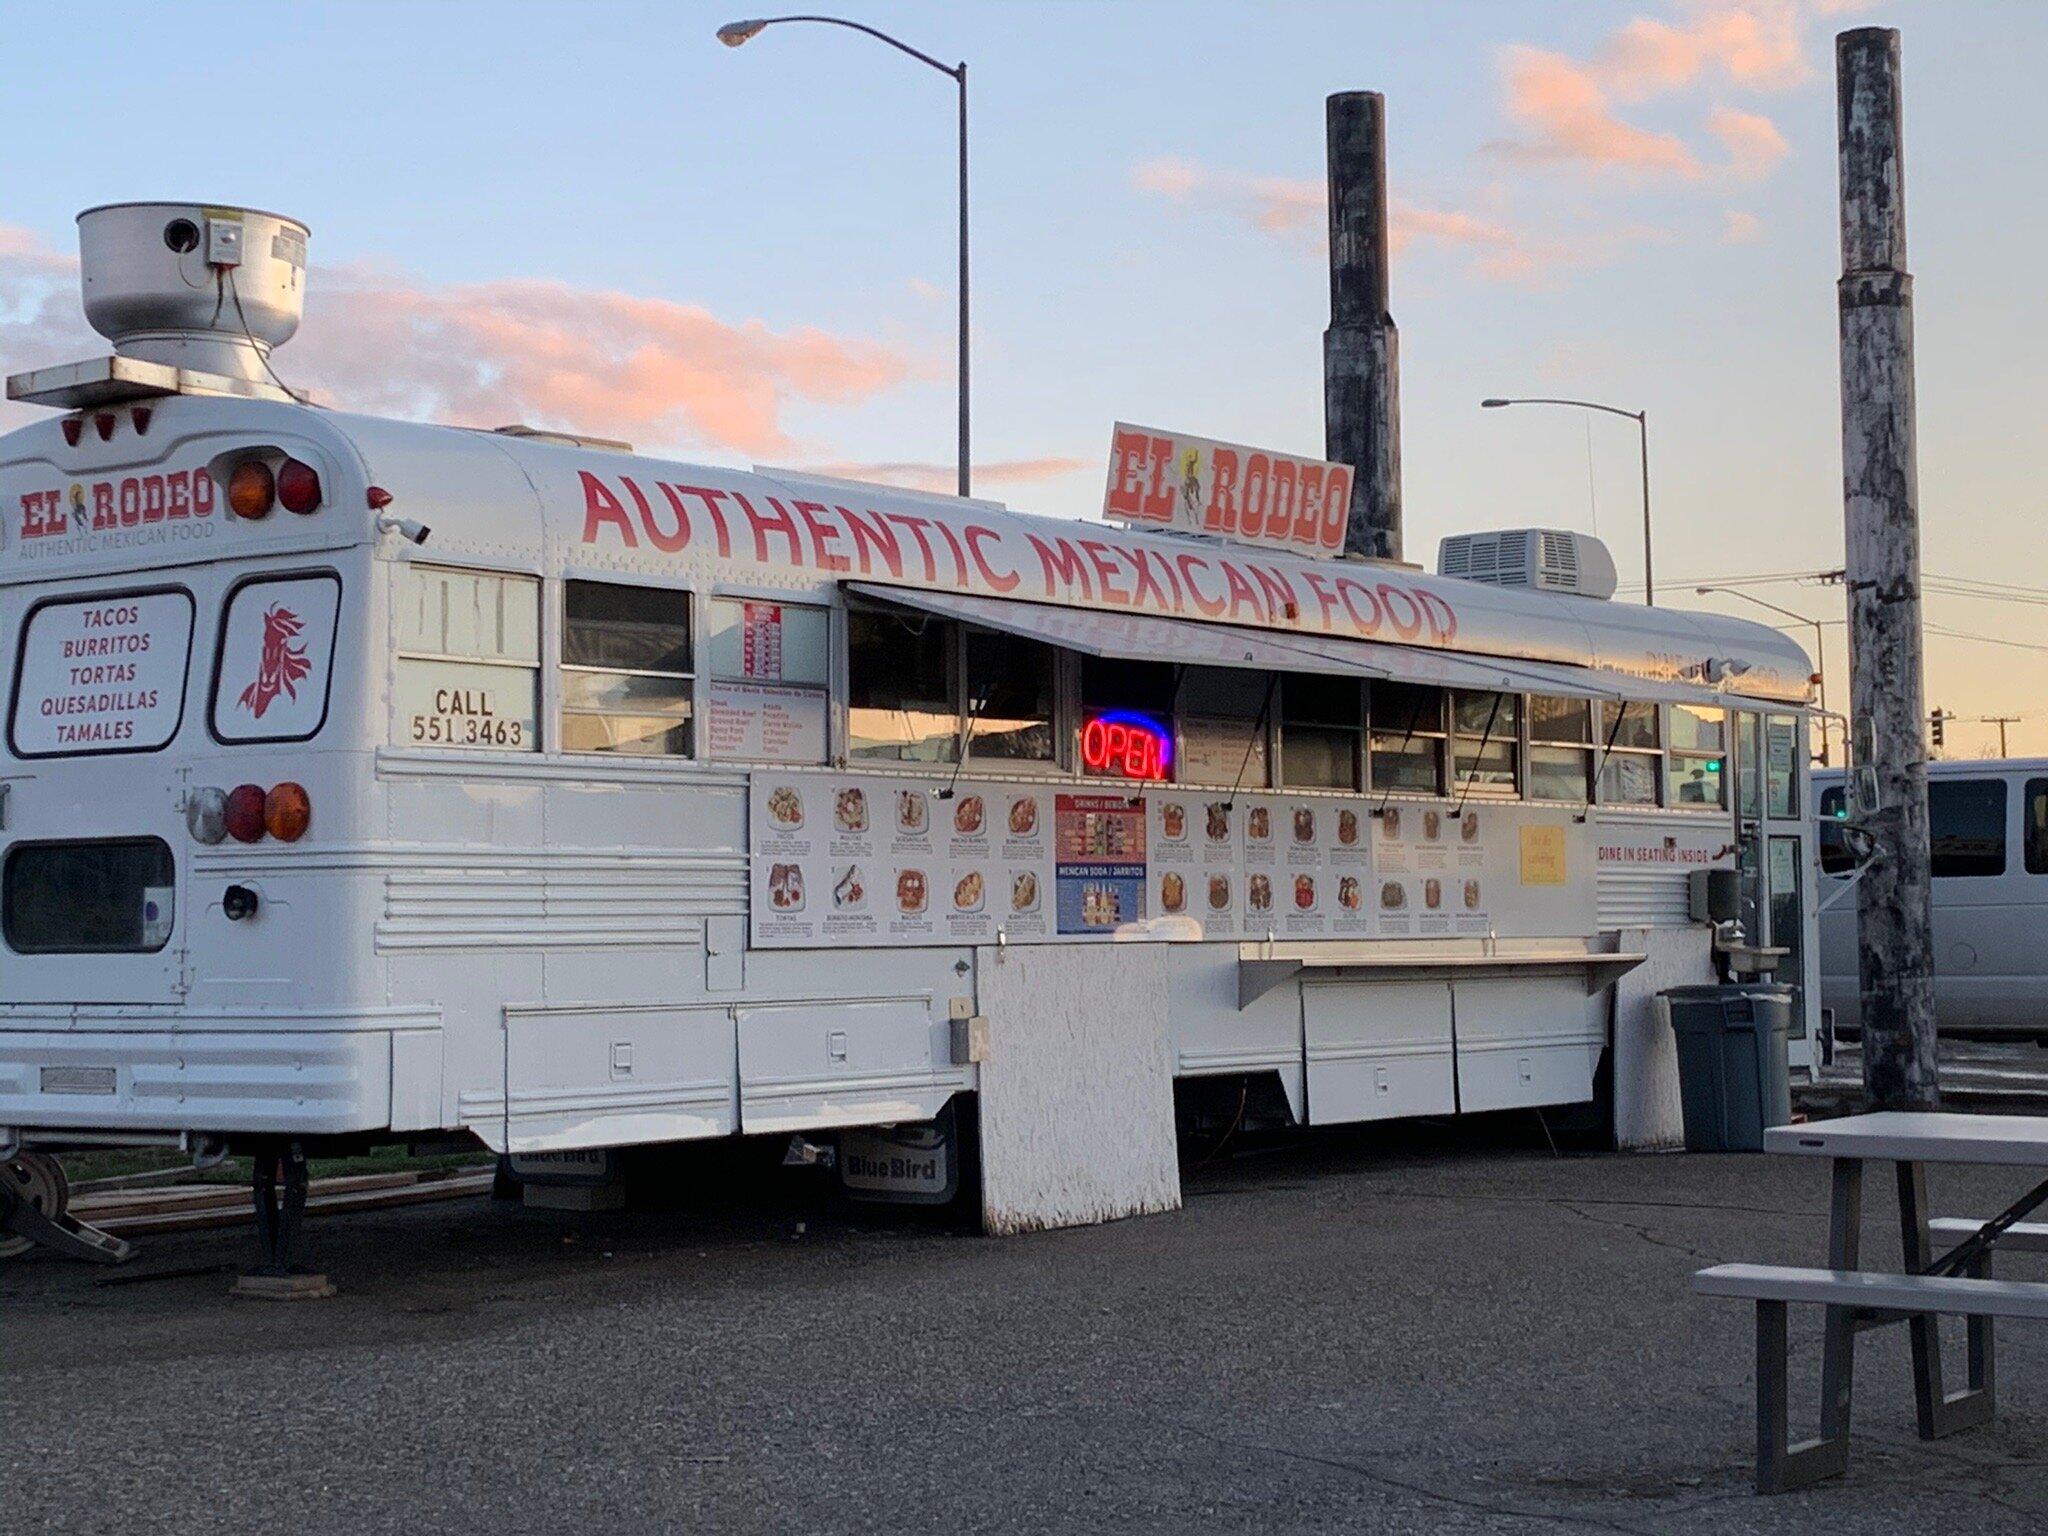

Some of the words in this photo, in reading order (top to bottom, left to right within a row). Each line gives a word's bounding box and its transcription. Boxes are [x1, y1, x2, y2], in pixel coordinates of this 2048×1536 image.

[21, 490, 67, 539] EL
[92, 467, 215, 531] RODEO
[1108, 430, 1176, 522] EL
[1204, 448, 1352, 550] RODEO
[20, 535, 99, 560] AUTHENTIC
[101, 526, 167, 549] MEXICAN
[172, 522, 215, 542] FOOD
[578, 470, 1020, 592] AUTHENTIC
[1026, 533, 1300, 627] MEXICAN
[1302, 571, 1458, 642] FOOD
[83, 606, 138, 628] TACOS
[63, 633, 150, 659] BURRITOS
[70, 663, 137, 686] TORTAS
[40, 689, 158, 717] QUESADILLAS
[436, 689, 493, 716] CALL
[57, 720, 134, 744] TAMALES
[1083, 719, 1164, 781] OPEN
[1599, 847, 1621, 861] DINE
[1624, 848, 1635, 861] IN
[1637, 848, 1676, 863] SEATING
[1678, 851, 1709, 864] INSIDE
